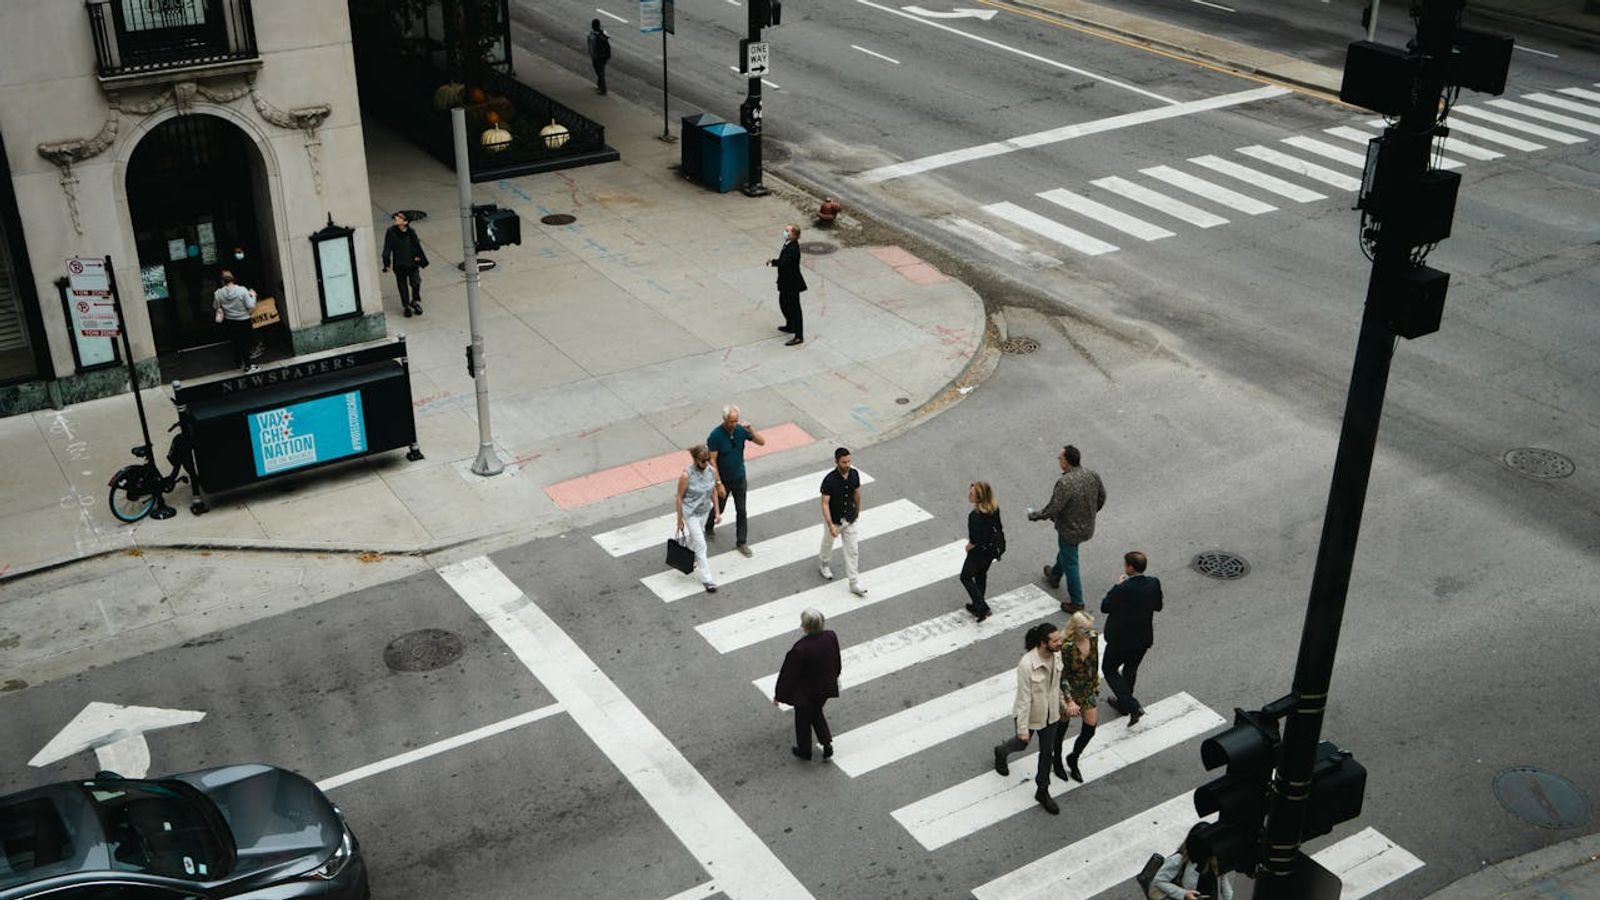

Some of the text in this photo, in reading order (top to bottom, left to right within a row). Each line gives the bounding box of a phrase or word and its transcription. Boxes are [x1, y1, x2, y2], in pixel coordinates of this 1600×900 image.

[751, 44, 766, 54] ONE
[751, 53, 767, 63] WAY
[221, 355, 356, 393] NEWSPAPERS
[259, 411, 286, 429] VAX
[264, 435, 313, 460] NATION
